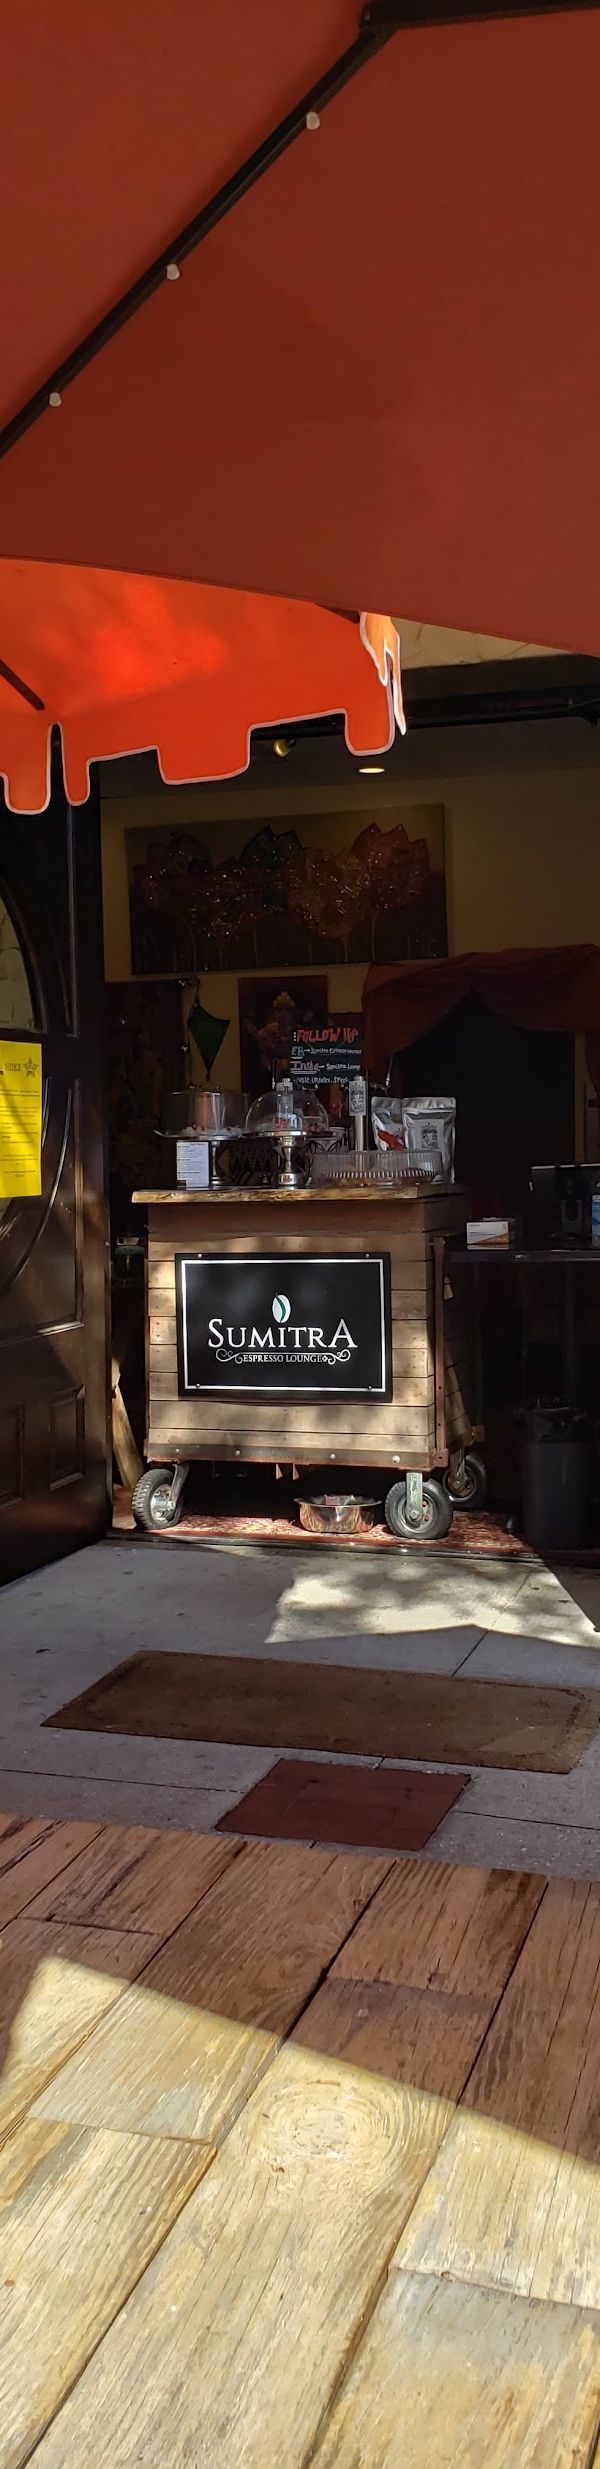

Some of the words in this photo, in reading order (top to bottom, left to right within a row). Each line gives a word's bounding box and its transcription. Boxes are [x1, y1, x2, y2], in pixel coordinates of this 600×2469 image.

[297, 1027, 340, 1042] FOLLOW
[289, 1061, 320, 1071] Insta
[208, 1318, 358, 1348] SUMITRA
[243, 1354, 284, 1363] ESPRESSO
[285, 1354, 322, 1364] LOUNGE
